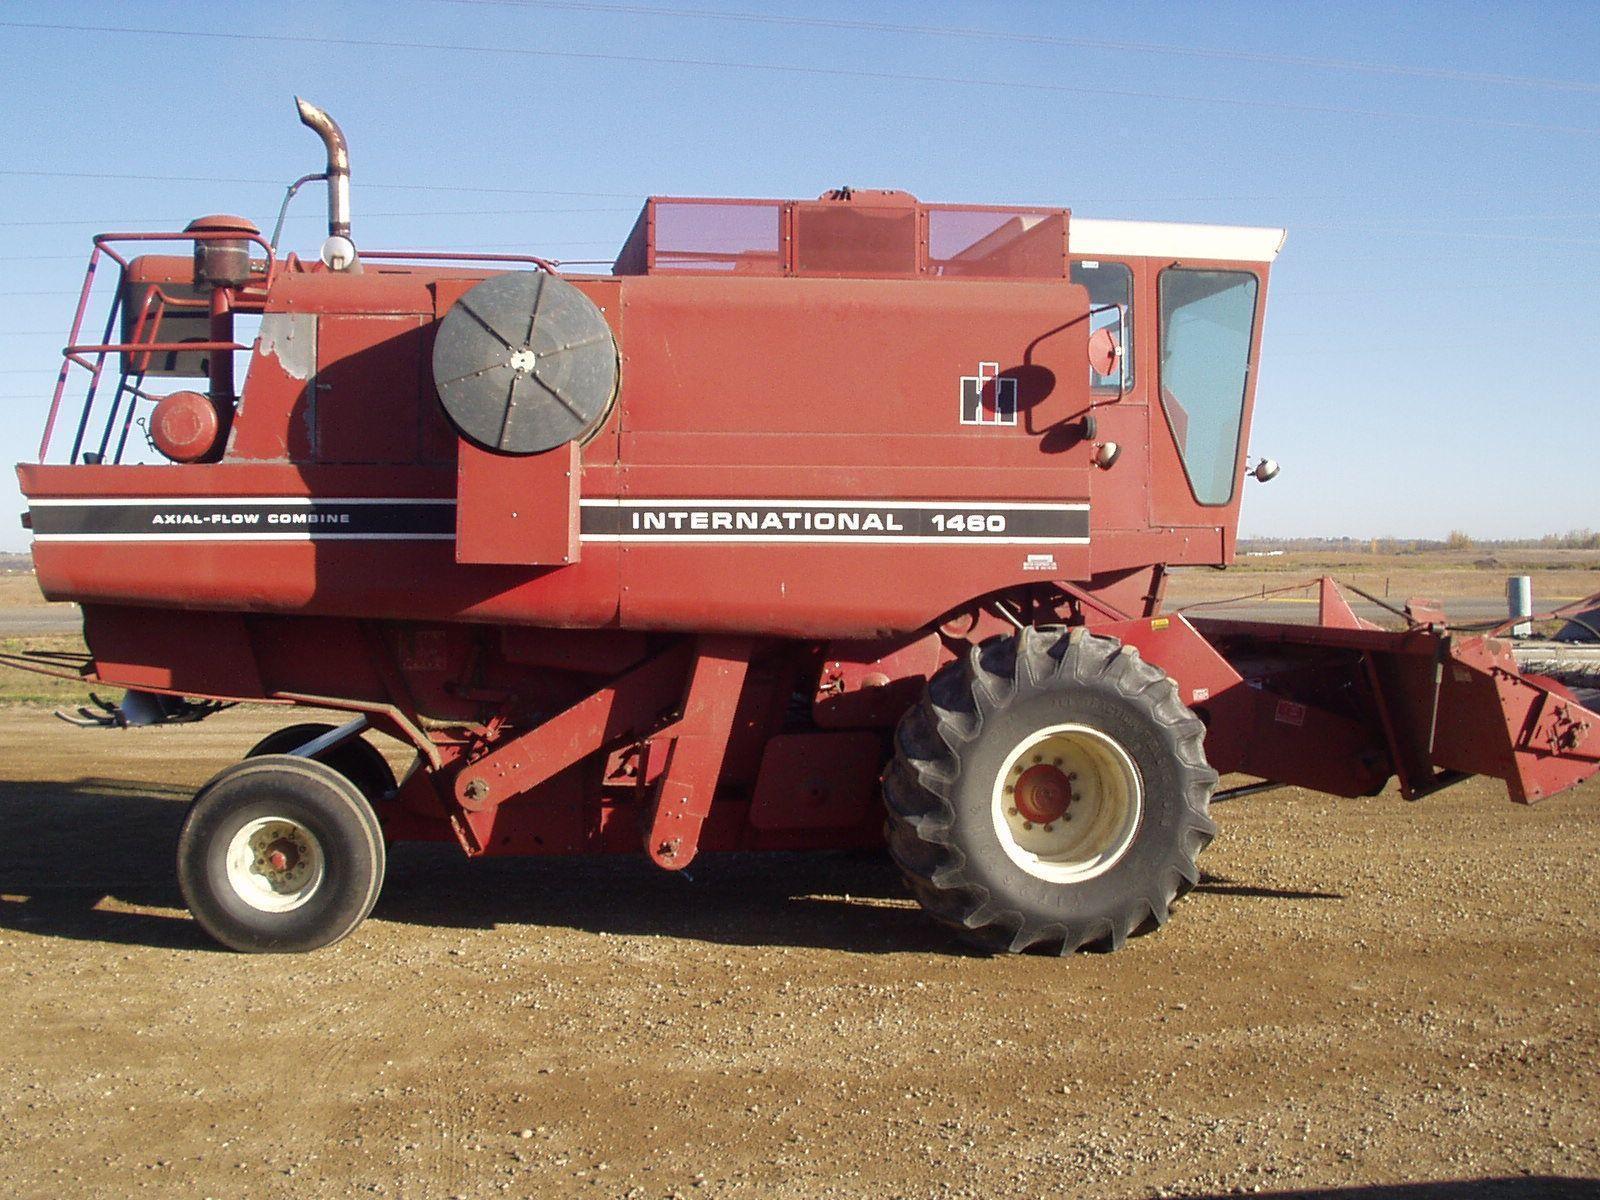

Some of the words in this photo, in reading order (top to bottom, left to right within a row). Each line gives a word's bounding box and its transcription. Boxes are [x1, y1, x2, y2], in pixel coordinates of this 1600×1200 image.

[152, 514, 259, 524] AXIAL-FLOW
[267, 514, 350, 523] COMBINE
[632, 512, 903, 532] INTERNATIONAL
[931, 514, 1006, 532] 1460
